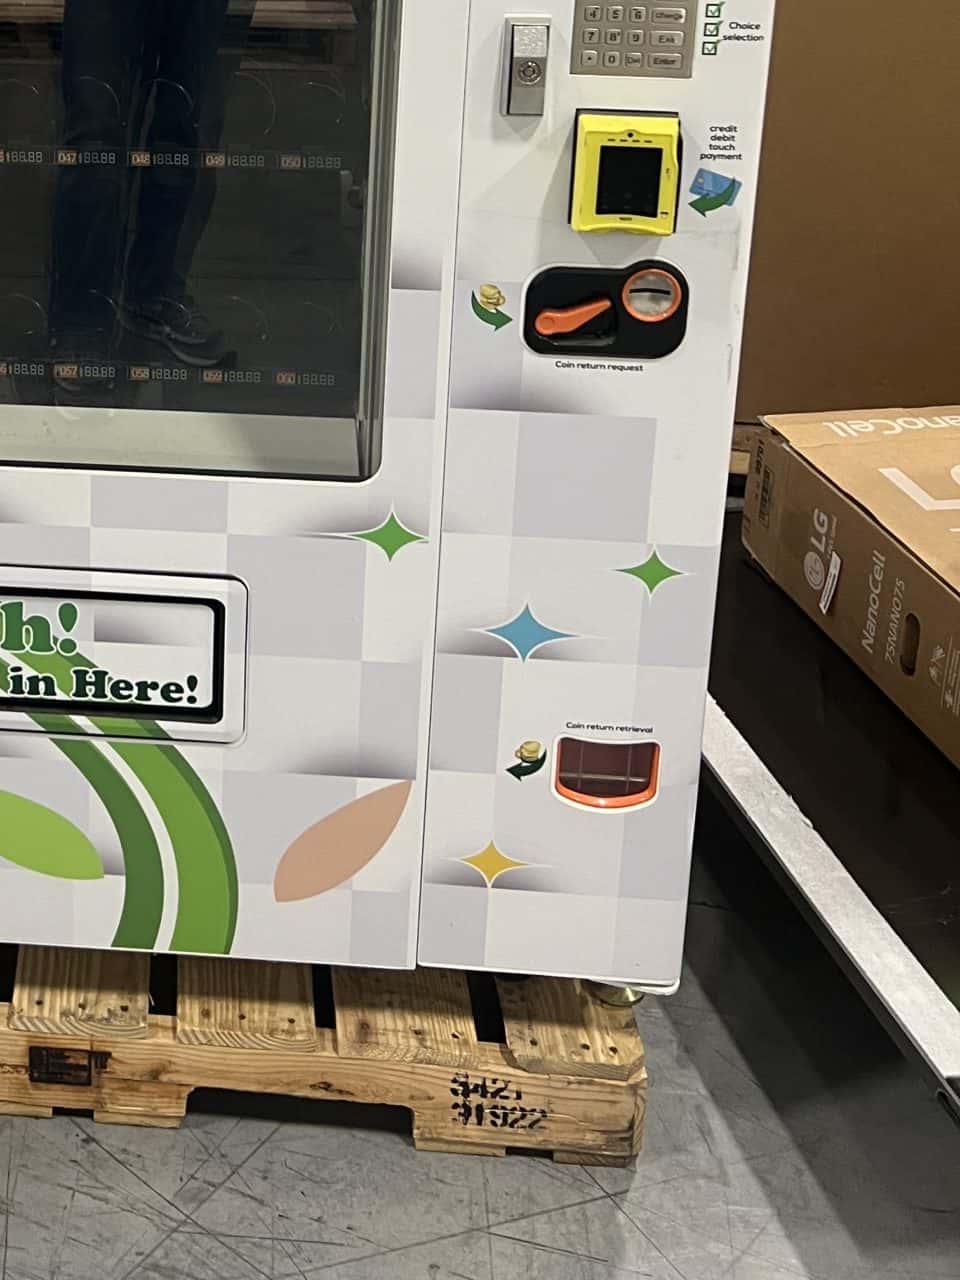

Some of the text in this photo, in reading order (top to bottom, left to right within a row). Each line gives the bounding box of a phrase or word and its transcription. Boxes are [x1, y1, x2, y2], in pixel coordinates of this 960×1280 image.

[612, 10, 619, 19] 5
[729, 22, 761, 31] Choice
[588, 31, 595, 40] 7
[609, 32, 617, 41] 8
[632, 33, 640, 42] 9
[723, 33, 765, 42] selection
[709, 125, 738, 133] credit
[710, 134, 736, 142] debit
[709, 143, 736, 151] touch
[700, 153, 742, 161] payment
[555, 360, 644, 373] Coin return request
[877, 465, 960, 511] L
[810, 508, 829, 553] LG
[861, 549, 887, 654] NanoCell
[8, 666, 57, 697] in
[70, 669, 200, 705] Here!
[566, 722, 654, 734] Coin return retrieval
